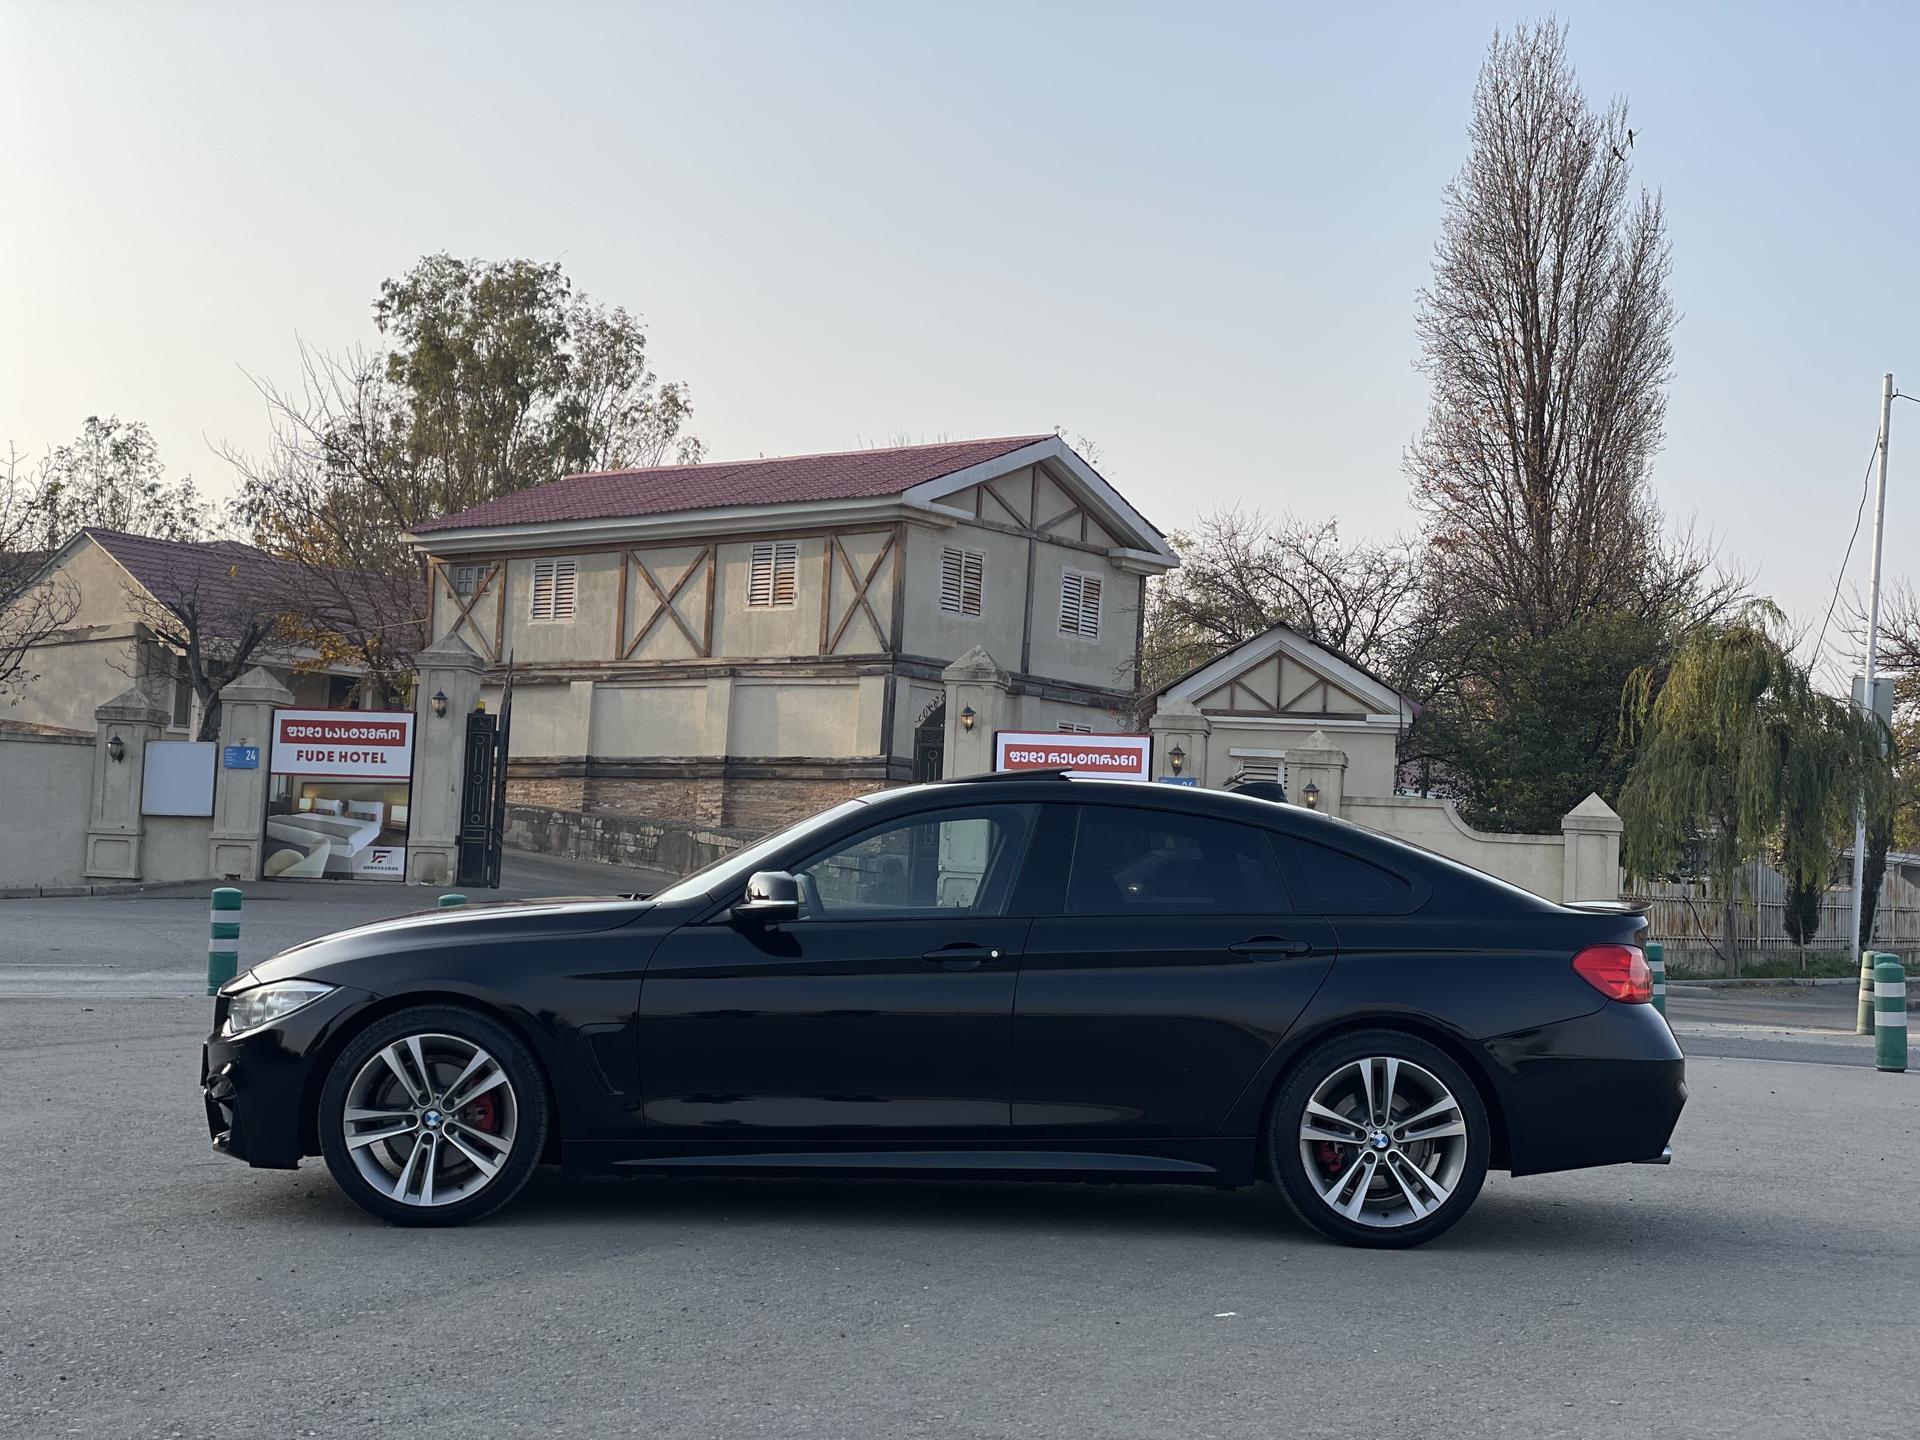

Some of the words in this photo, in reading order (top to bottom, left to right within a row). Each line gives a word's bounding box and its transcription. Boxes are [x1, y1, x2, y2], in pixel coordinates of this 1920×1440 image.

[287, 726, 322, 738] ფუდე
[325, 728, 400, 740] სასტუმრო
[245, 750, 256, 761] 24
[296, 750, 335, 763] FUDE
[338, 751, 387, 764] HOTEL
[1009, 751, 1046, 763] ფუდე
[1047, 753, 1137, 767] რესტორანი
